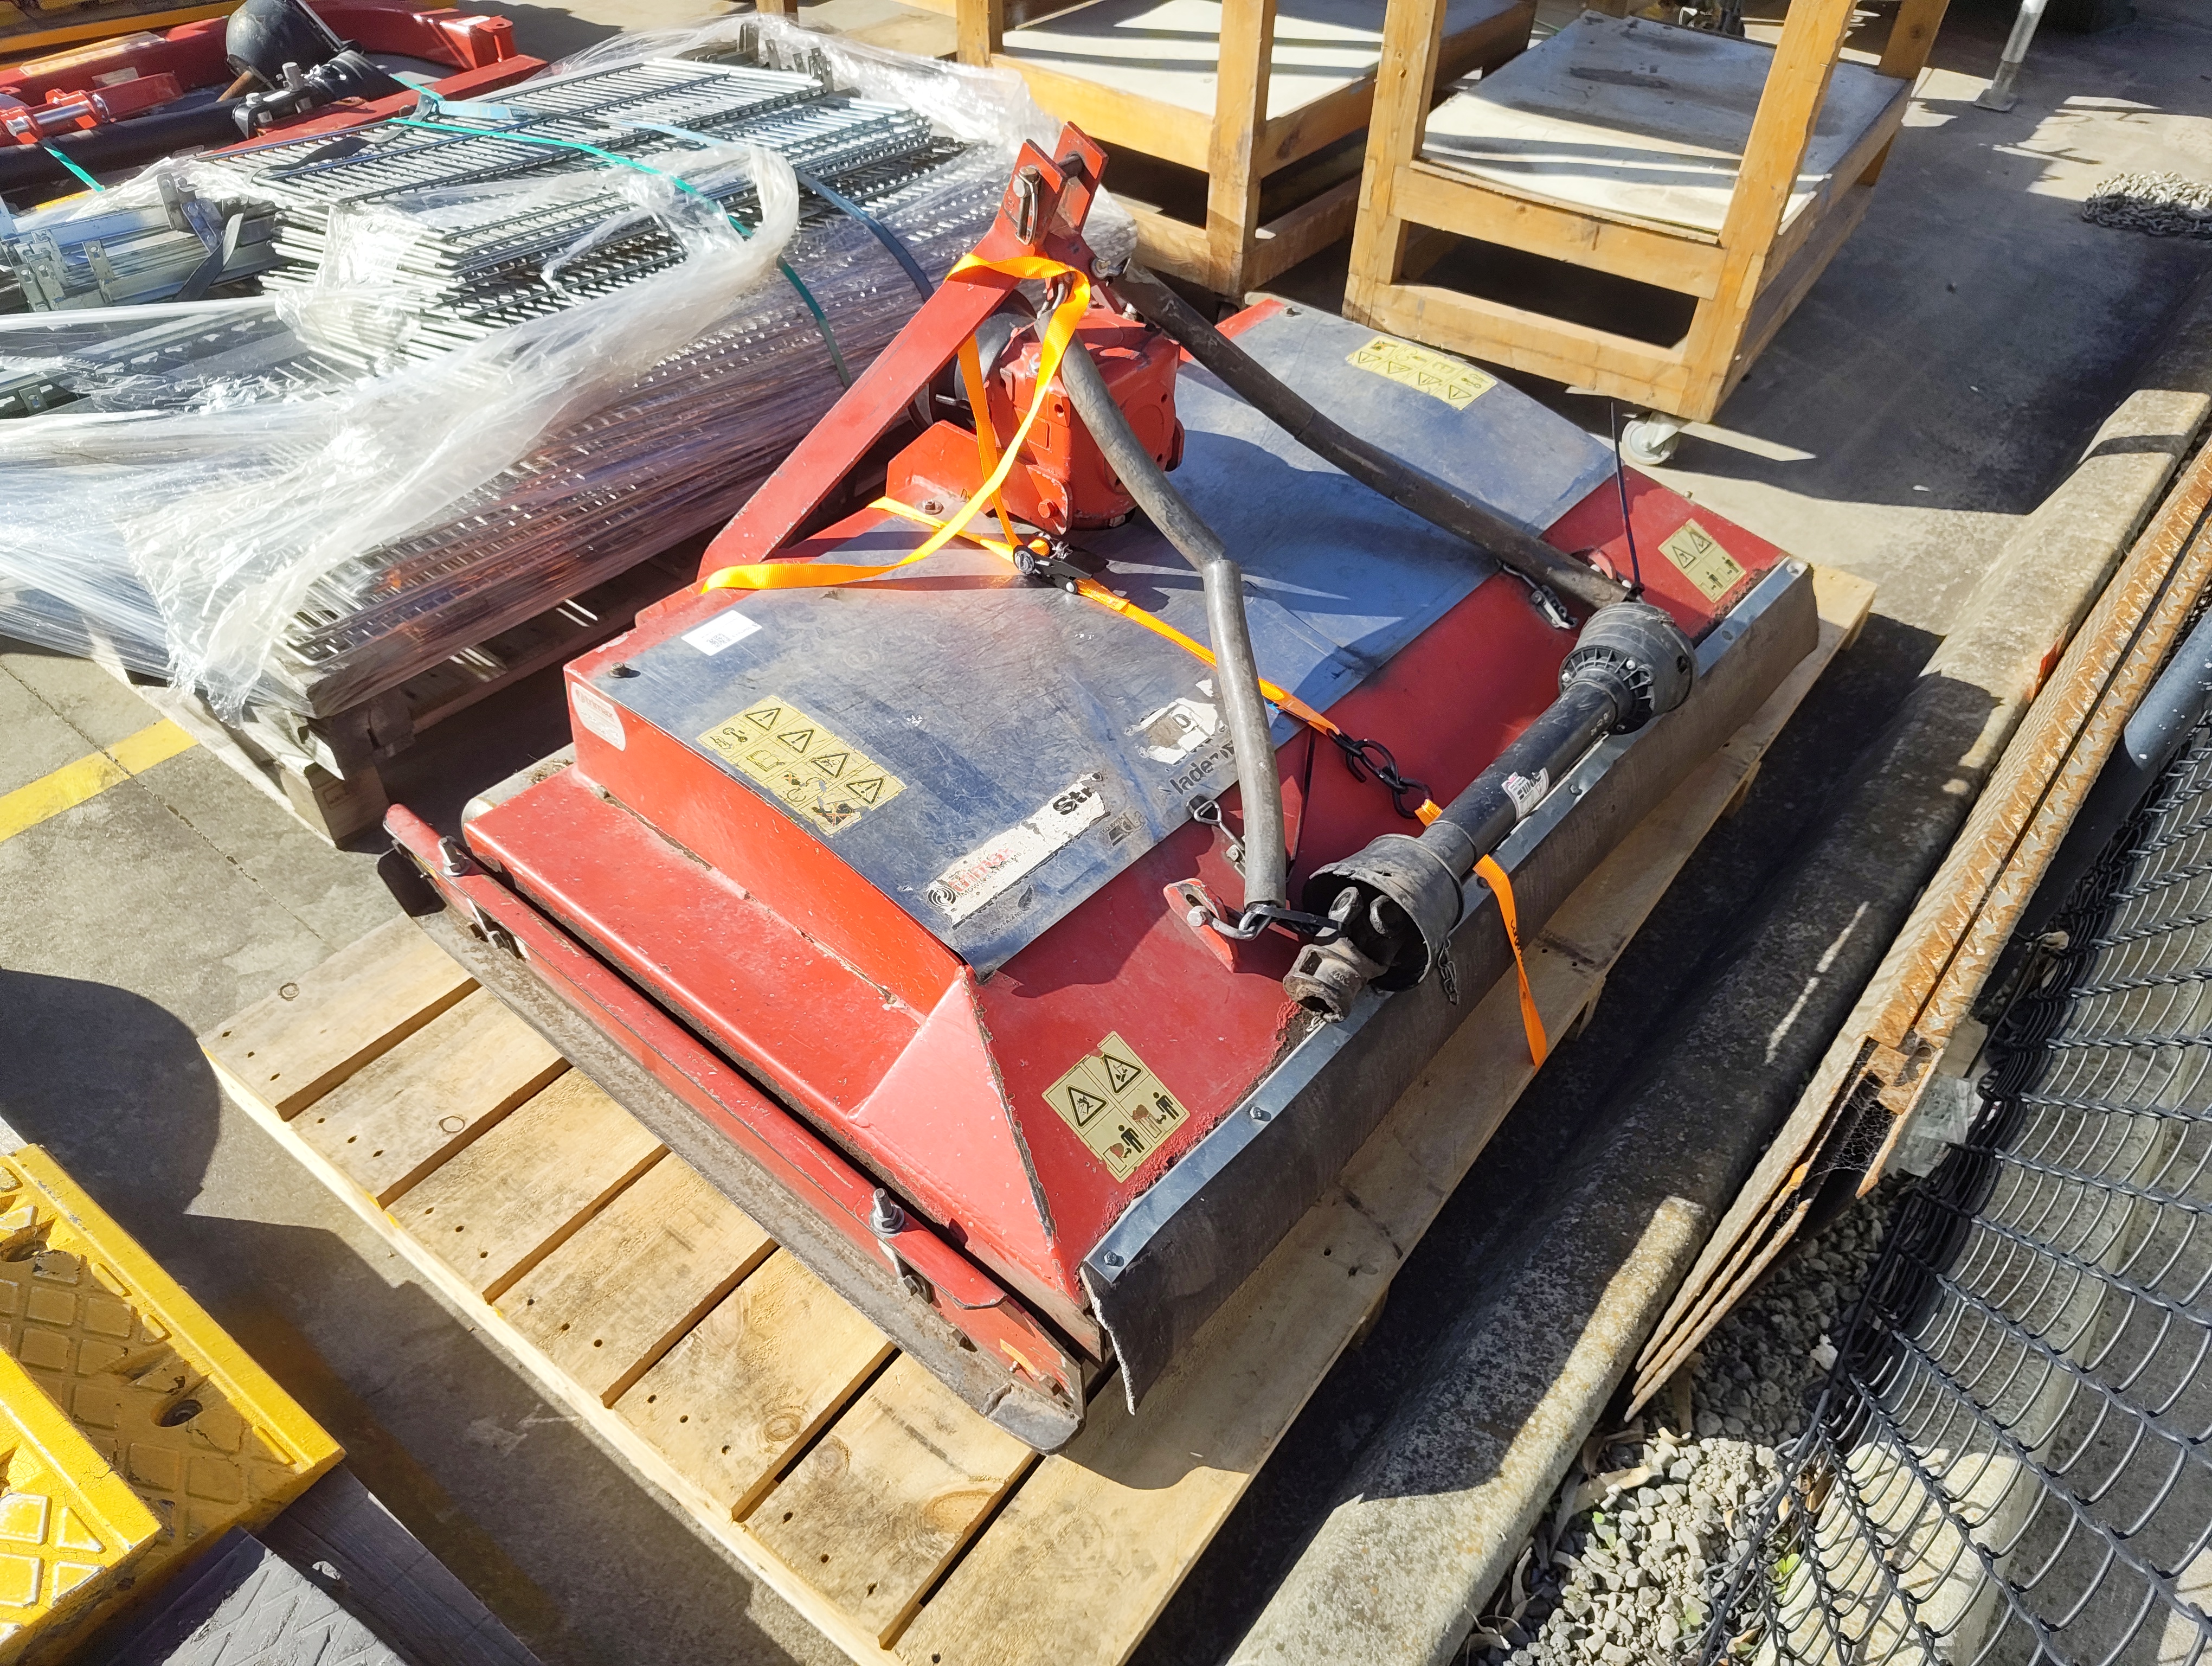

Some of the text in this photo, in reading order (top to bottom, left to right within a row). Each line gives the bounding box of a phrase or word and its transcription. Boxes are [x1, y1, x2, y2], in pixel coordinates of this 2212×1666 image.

[584, 696, 614, 719] trimax
[948, 848, 1015, 892] trimax
[960, 852, 1022, 897] MOWING SYSTEMS
